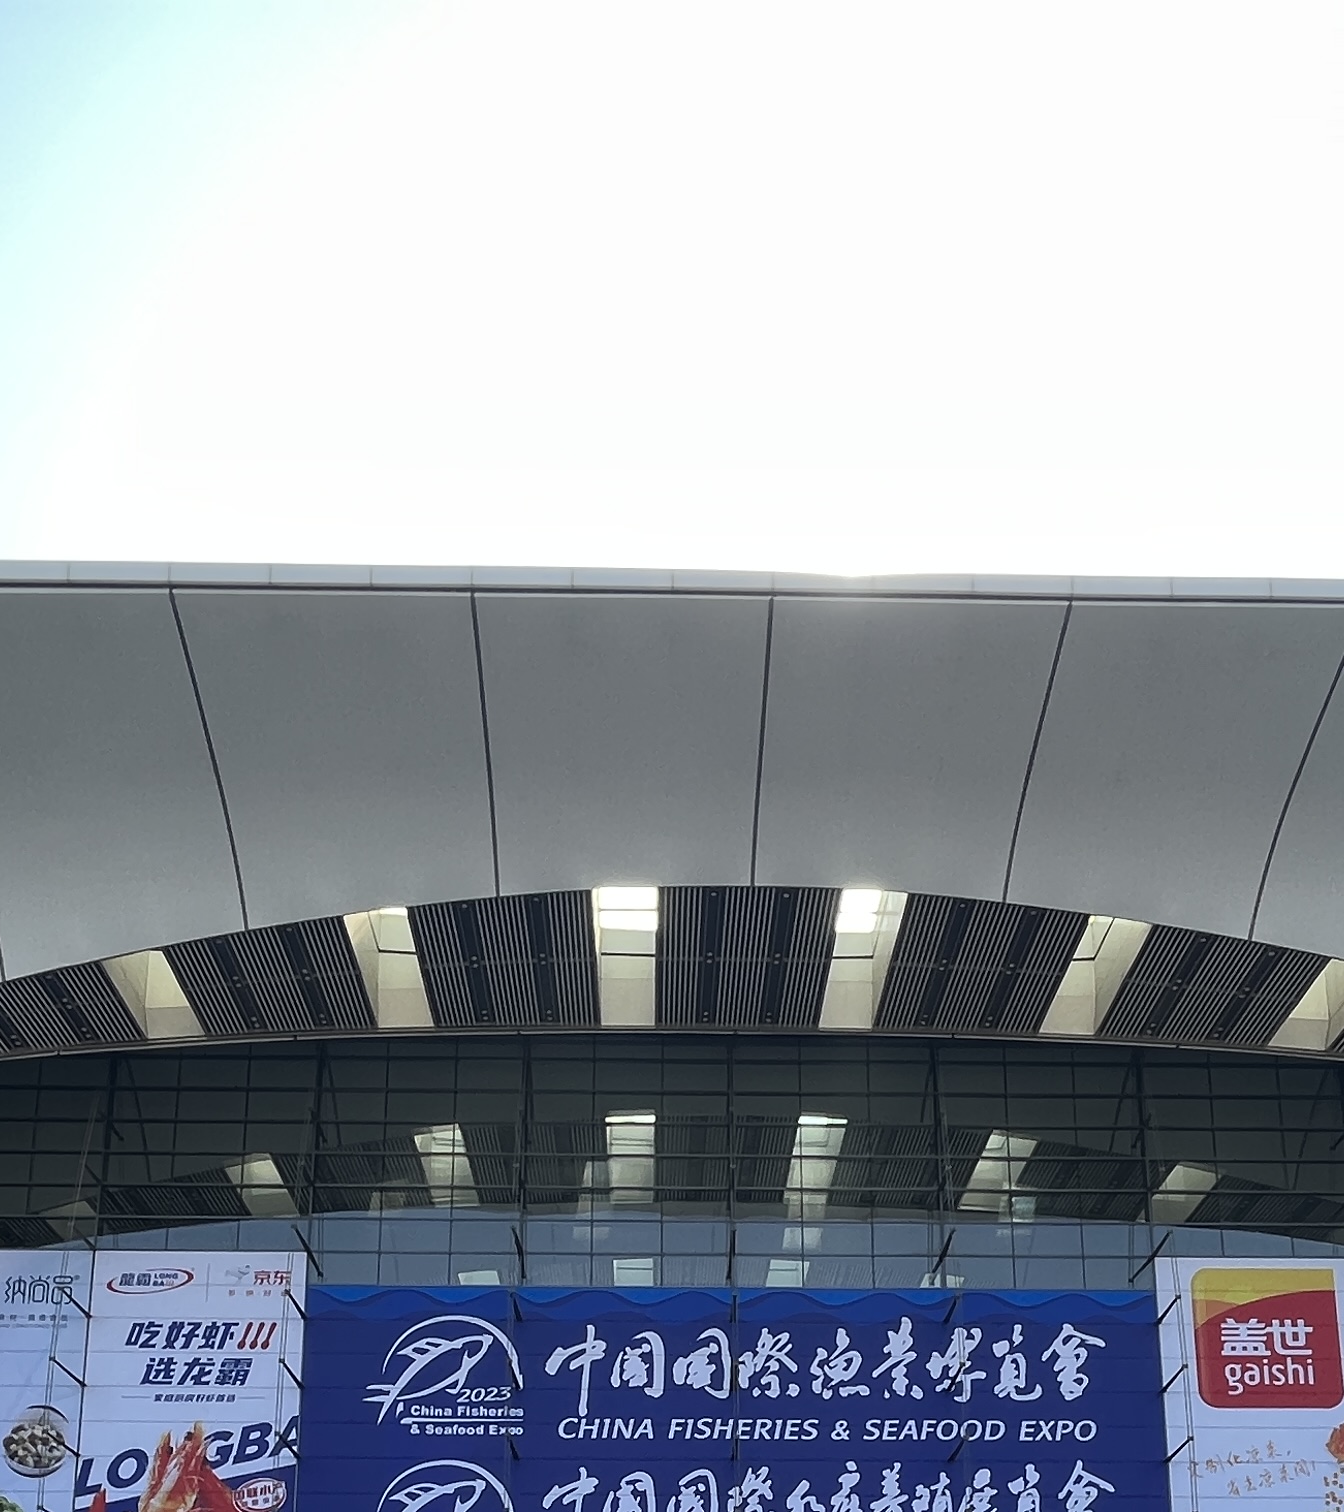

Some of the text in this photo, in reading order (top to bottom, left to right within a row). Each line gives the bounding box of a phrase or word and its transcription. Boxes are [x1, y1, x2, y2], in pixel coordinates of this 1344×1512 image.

[1221, 1318, 1314, 1356] 盖世
[140, 1357, 254, 1386] 选龙霸
[1224, 1357, 1316, 1396] gaishi
[456, 1386, 512, 1403] 2023
[410, 1405, 524, 1417] China Fisheries
[410, 1424, 524, 1435] & Seafood Expo
[558, 1418, 1097, 1442] CHINA FISHERIES & SEAFOOD EXPO
